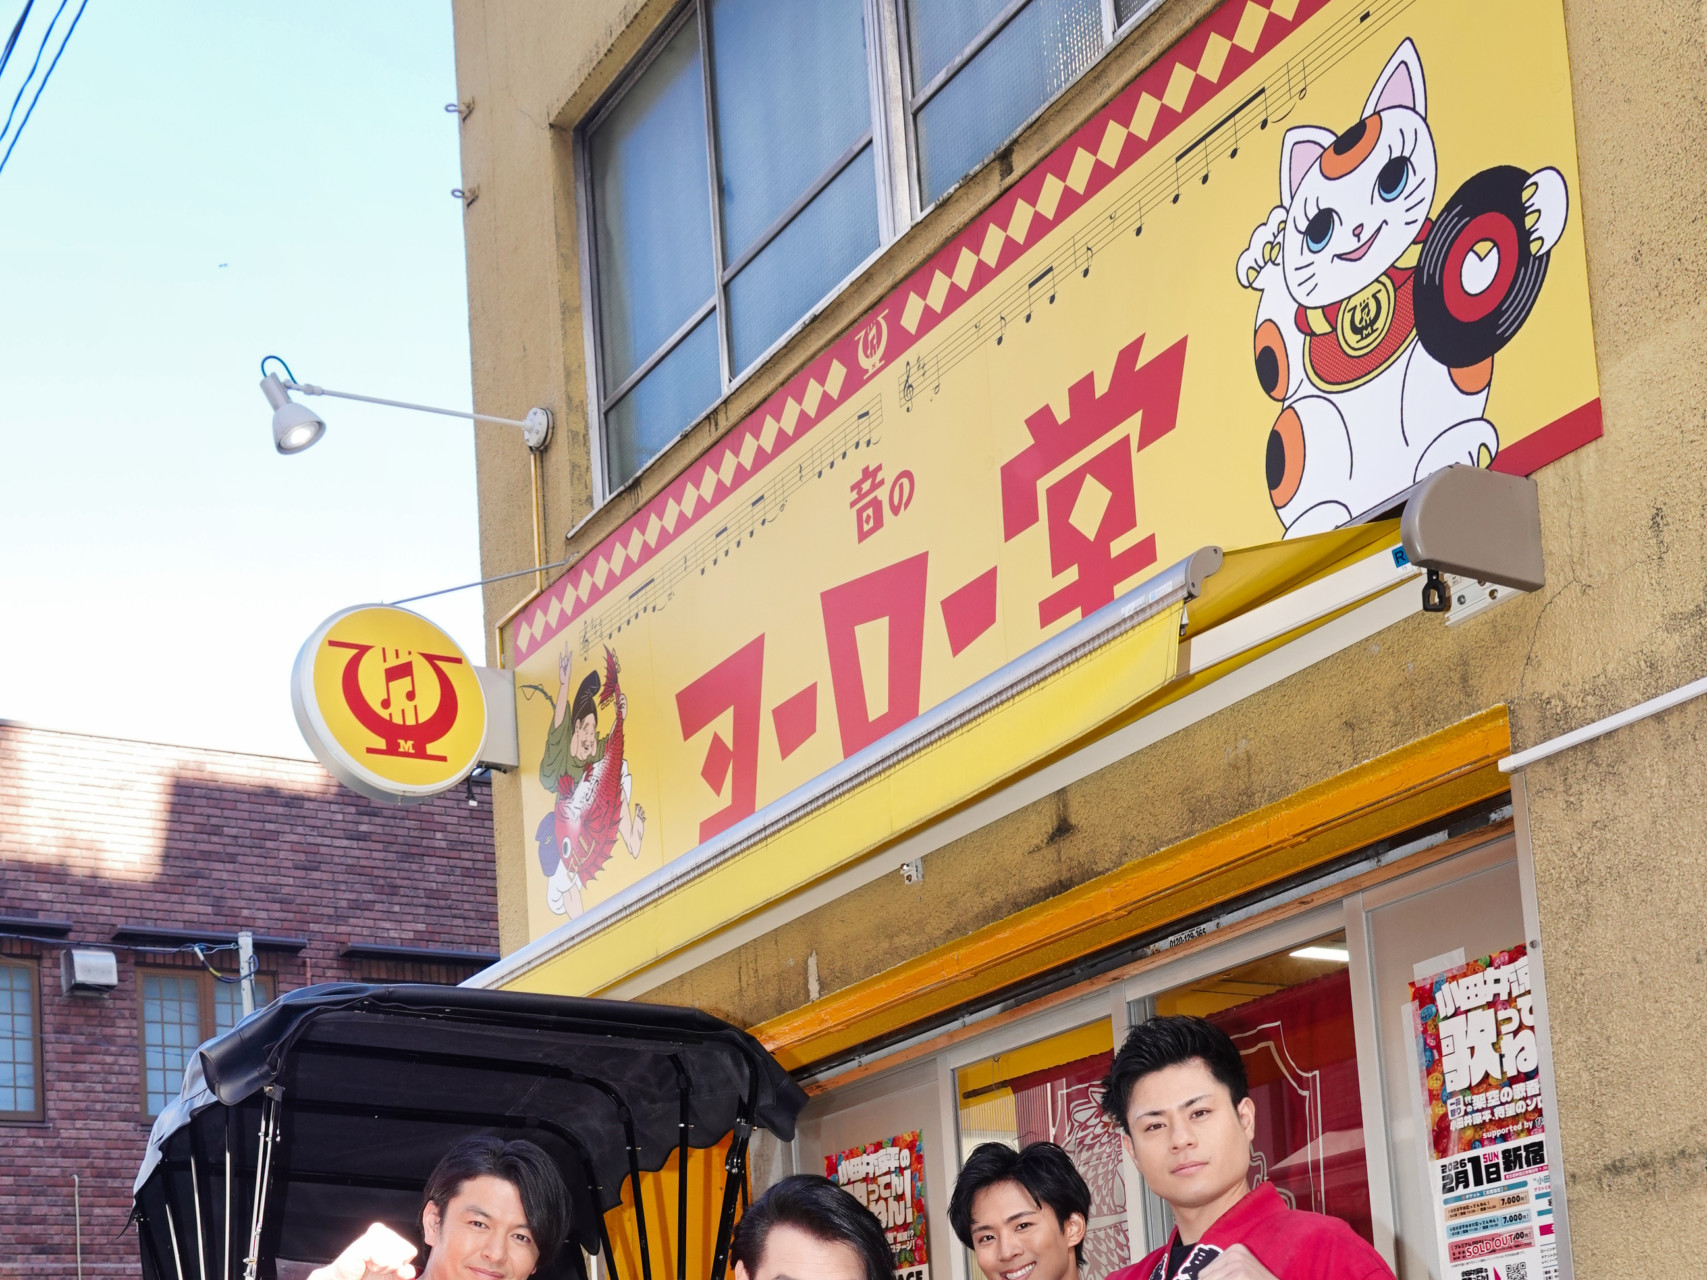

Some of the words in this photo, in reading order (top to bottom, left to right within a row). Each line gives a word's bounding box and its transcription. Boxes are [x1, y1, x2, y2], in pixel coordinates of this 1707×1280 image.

[849, 463, 916, 544] 音の
[1394, 550, 1407, 564] R
[675, 331, 1189, 845] ヨーロー堂
[1482, 1122, 1522, 1139] supported
[1524, 1120, 1534, 1129] by
[1441, 1159, 1467, 1174] 2026
[1482, 1151, 1500, 1164] SUN
[1501, 1140, 1546, 1173] 新宿
[1465, 1239, 1493, 1258] SOLD
[1494, 1233, 1514, 1248] OUT
